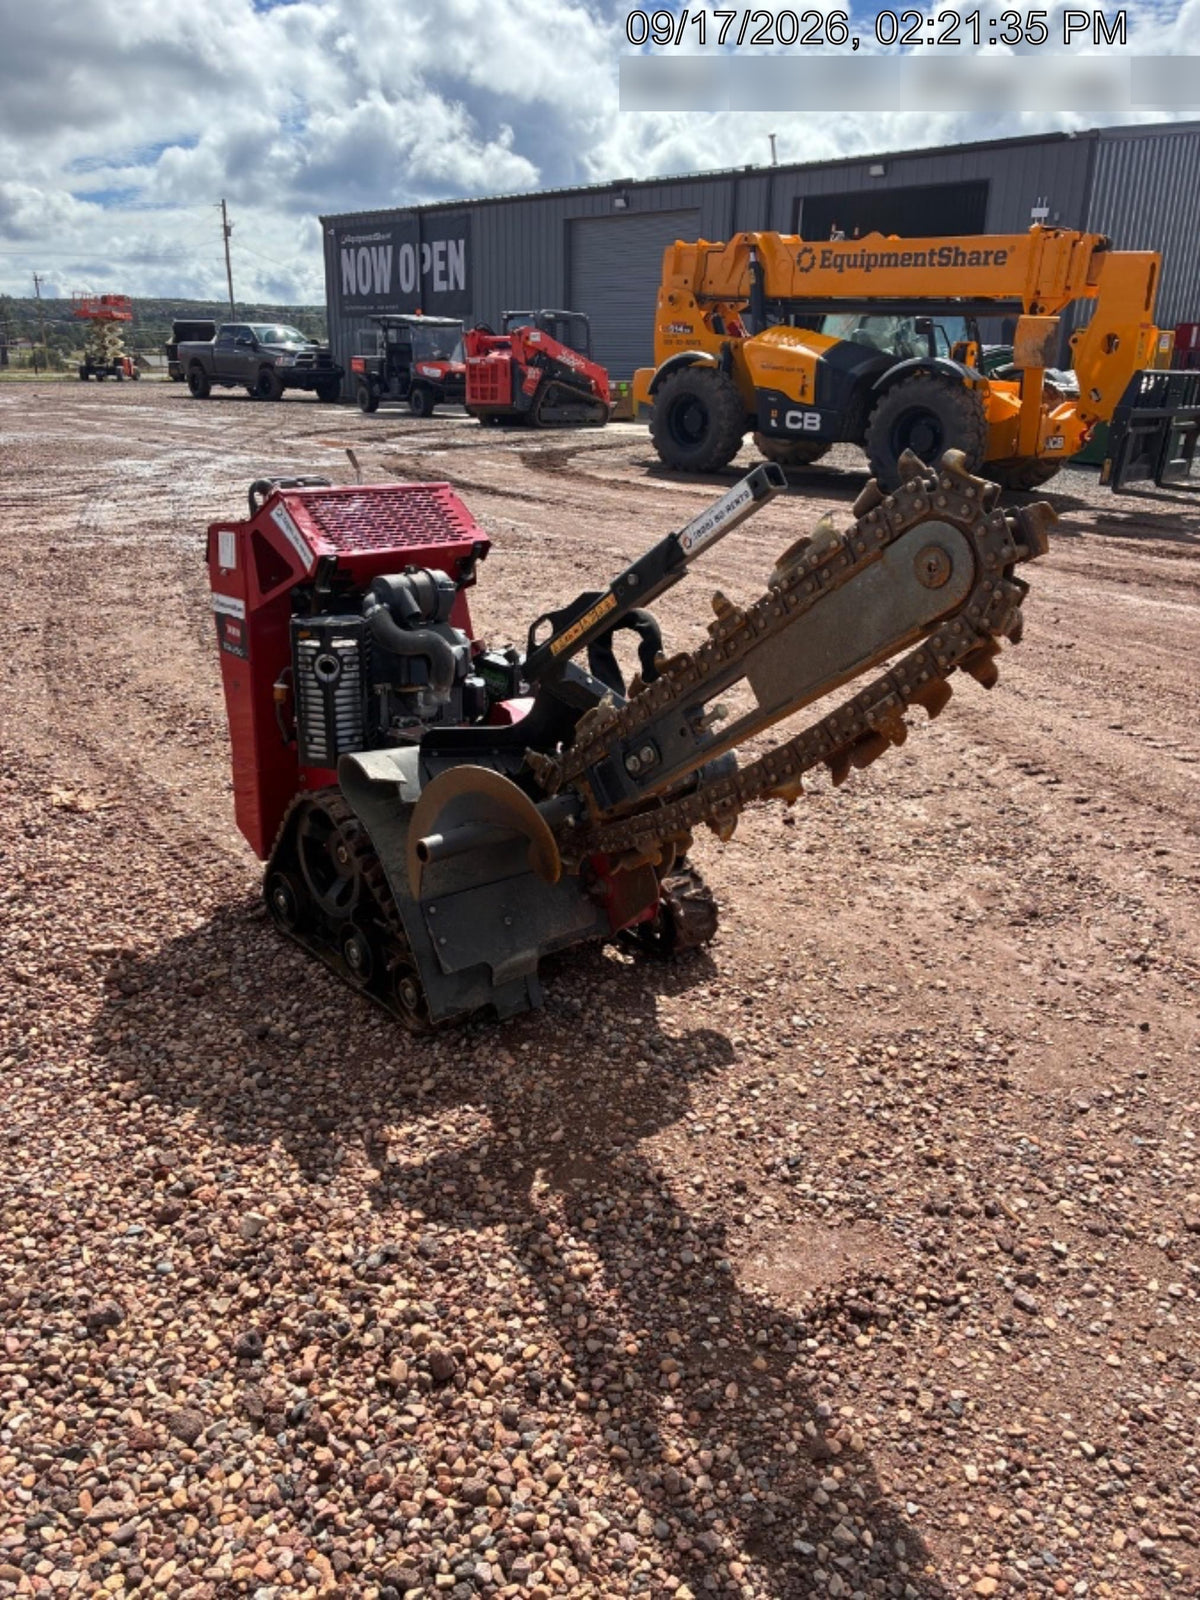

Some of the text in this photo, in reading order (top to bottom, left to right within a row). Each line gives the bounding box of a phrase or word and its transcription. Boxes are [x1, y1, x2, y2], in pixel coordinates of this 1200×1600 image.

[341, 239, 464, 296] NOW OPEN
[819, 246, 1008, 273] EquipmentShare
